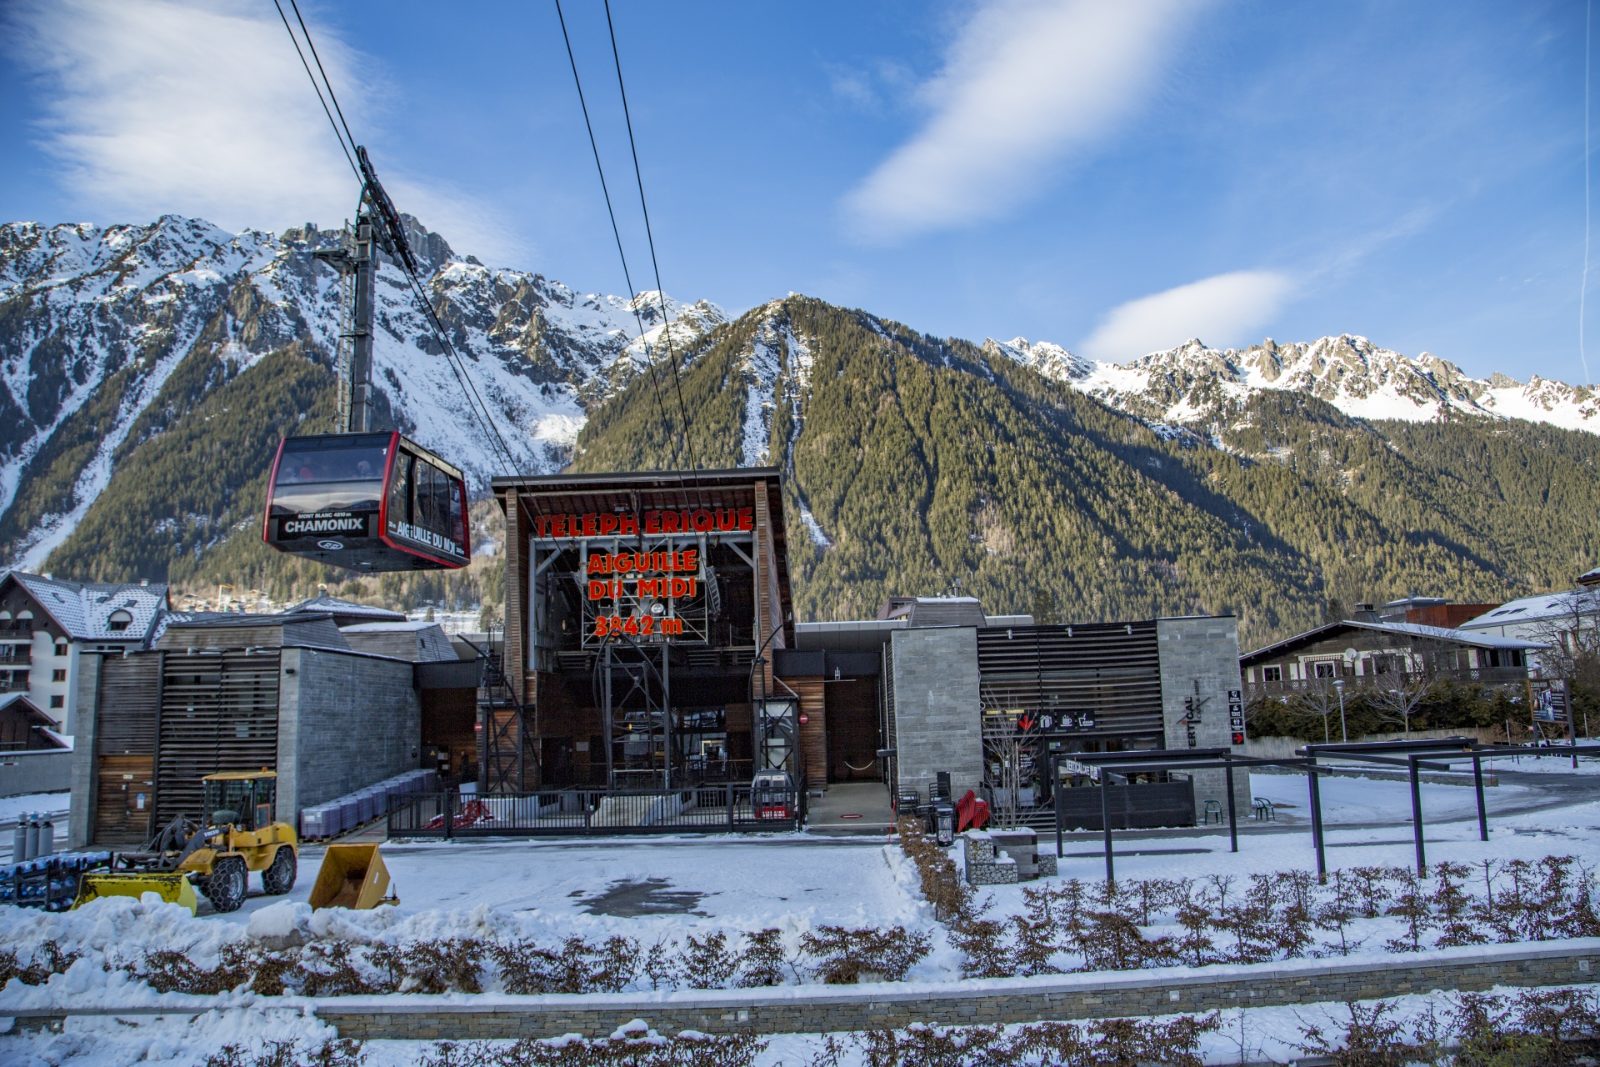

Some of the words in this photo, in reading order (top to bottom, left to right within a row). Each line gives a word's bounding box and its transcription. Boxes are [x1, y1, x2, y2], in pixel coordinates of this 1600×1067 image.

[285, 518, 363, 532] CHAMONIX
[433, 533, 443, 549] DU
[587, 550, 697, 574] AIGUILLE
[588, 579, 623, 601] DU
[637, 576, 696, 599] MIDI
[595, 615, 654, 637] 3842
[661, 618, 682, 635] m
